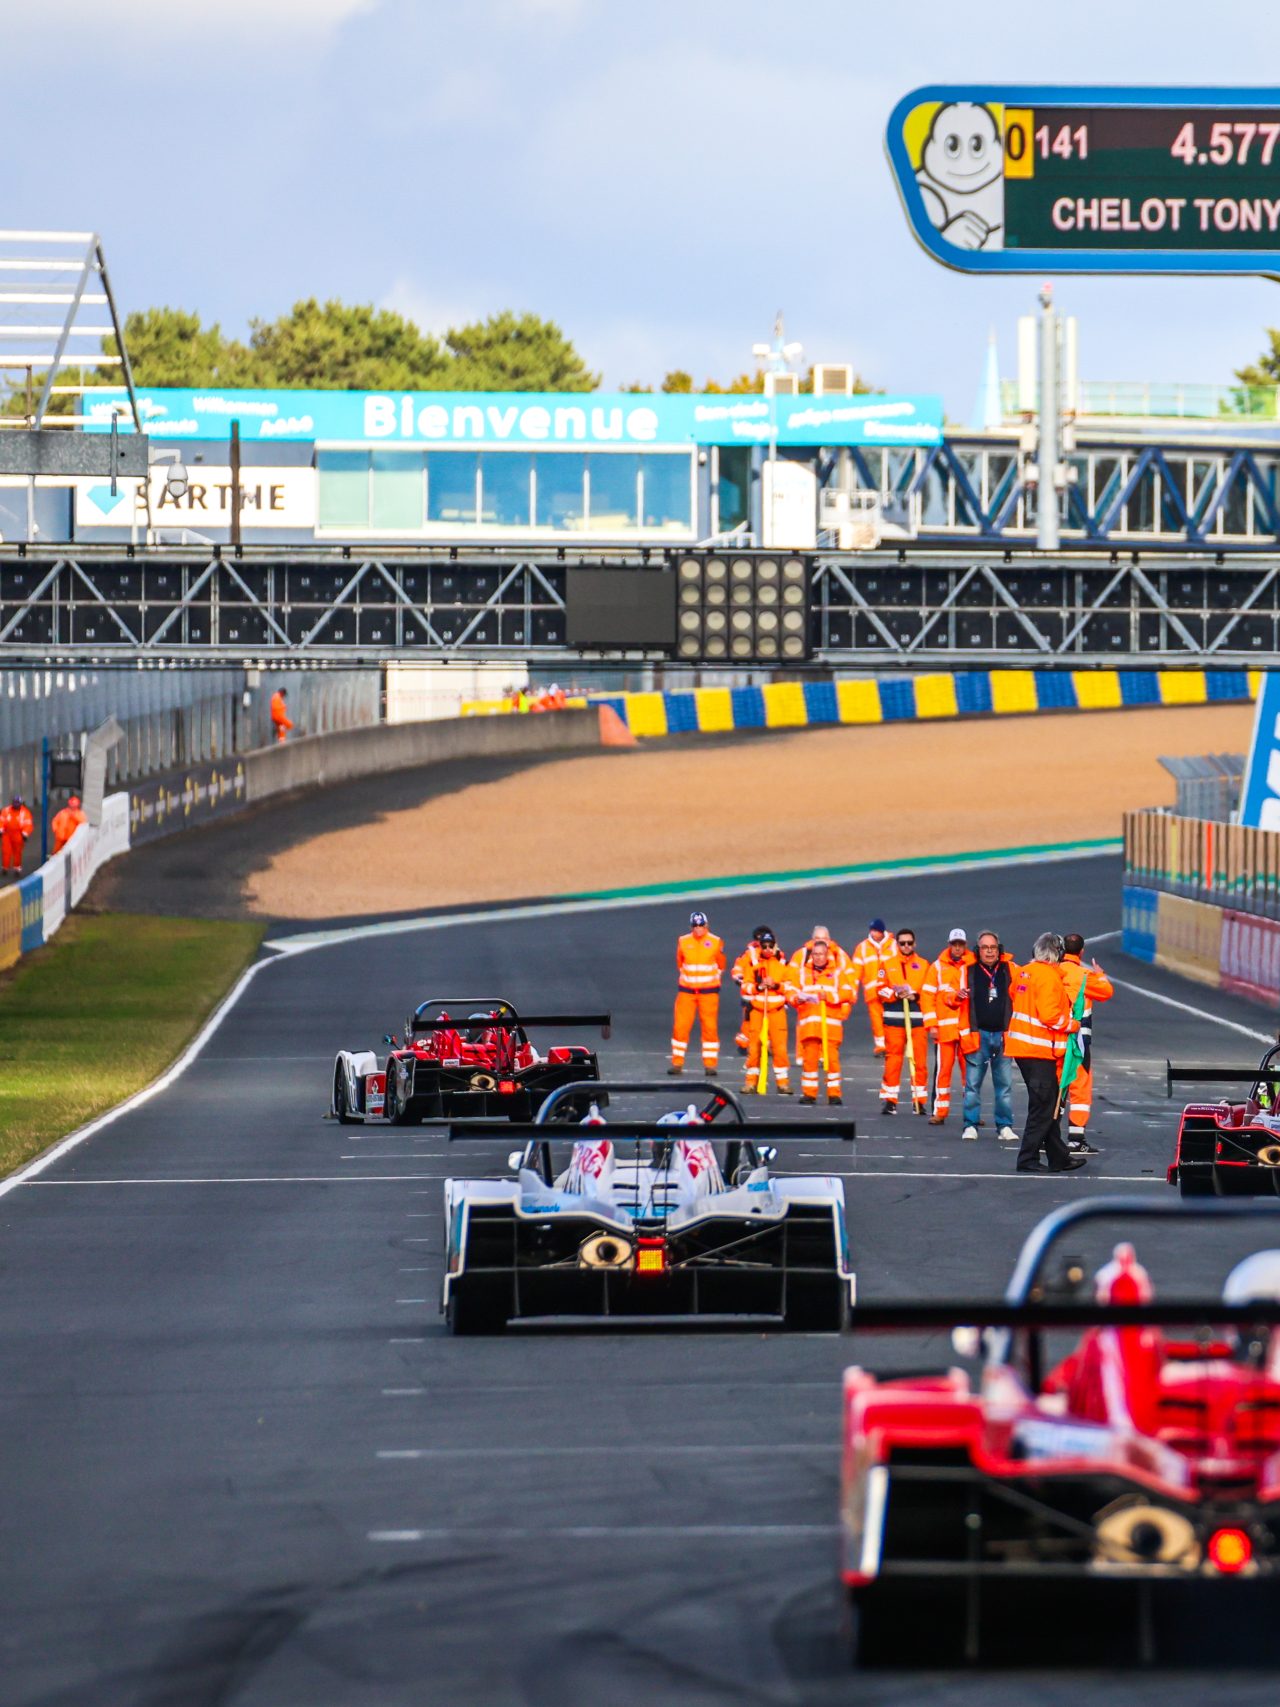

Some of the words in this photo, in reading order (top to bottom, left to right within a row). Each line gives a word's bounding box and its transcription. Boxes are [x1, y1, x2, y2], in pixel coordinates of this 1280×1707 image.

[1035, 124, 1089, 160] 141
[1051, 197, 1188, 232] CHELOT
[363, 394, 659, 440] Bienvenue
